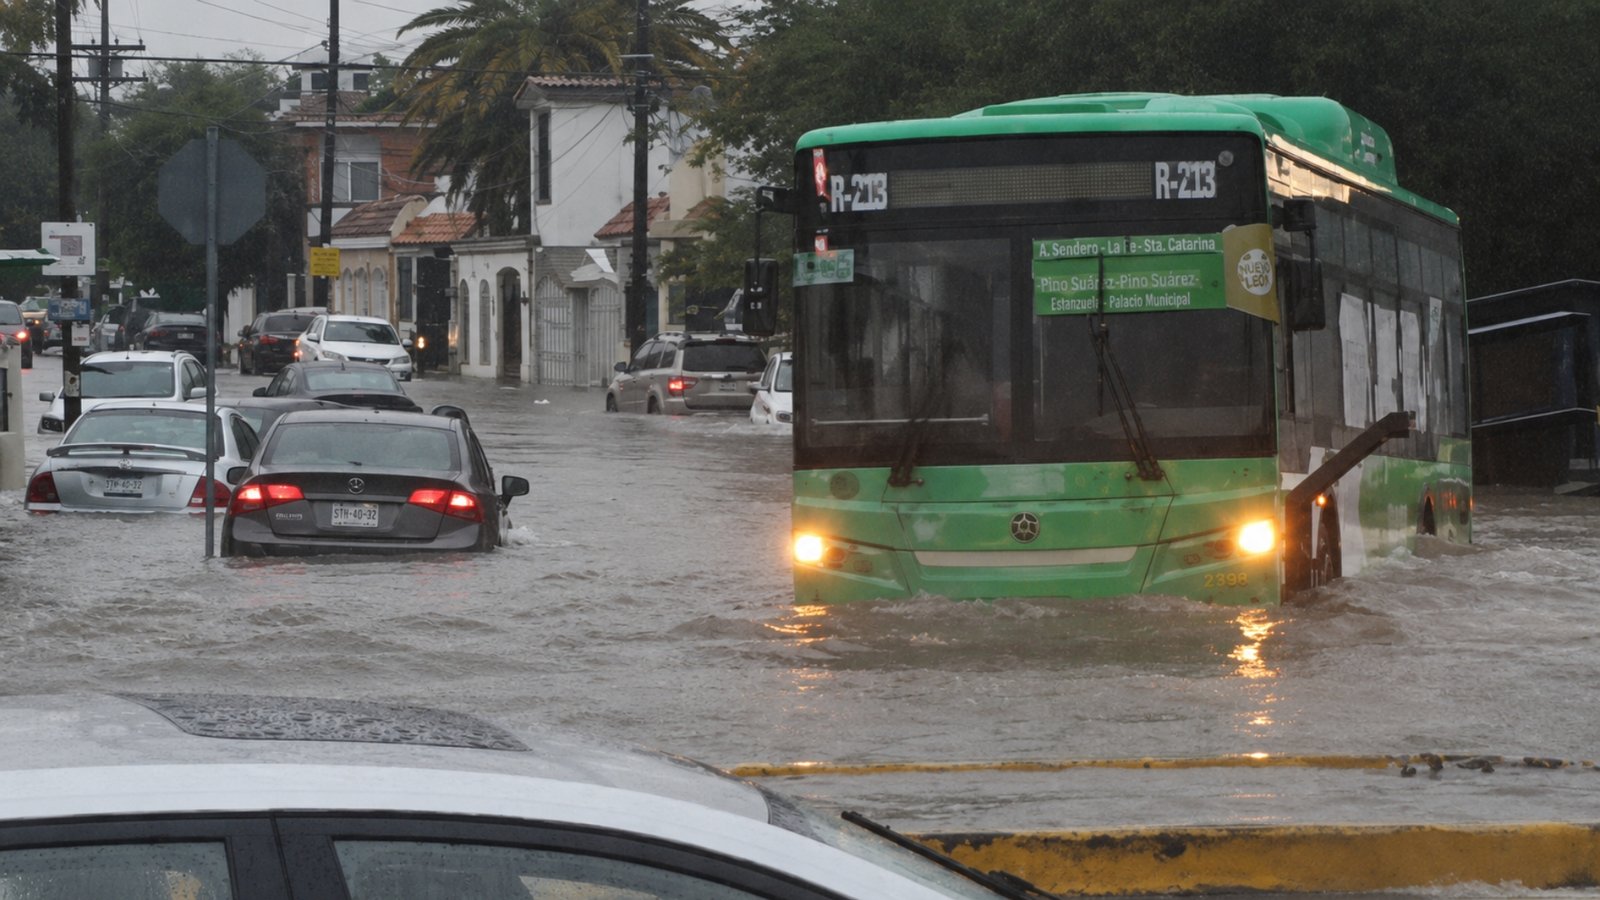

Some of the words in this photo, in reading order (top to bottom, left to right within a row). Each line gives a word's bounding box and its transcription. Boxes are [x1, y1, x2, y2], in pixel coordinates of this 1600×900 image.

[830, 172, 887, 212] R-213
[1155, 161, 1216, 199] R-213
[1052, 241, 1098, 256] Sendero
[1108, 240, 1120, 254] La
[1144, 239, 1166, 253] Sta.
[1168, 237, 1215, 251] Catarina
[1109, 295, 1143, 309] Palacio
[1145, 292, 1191, 308] Municipal
